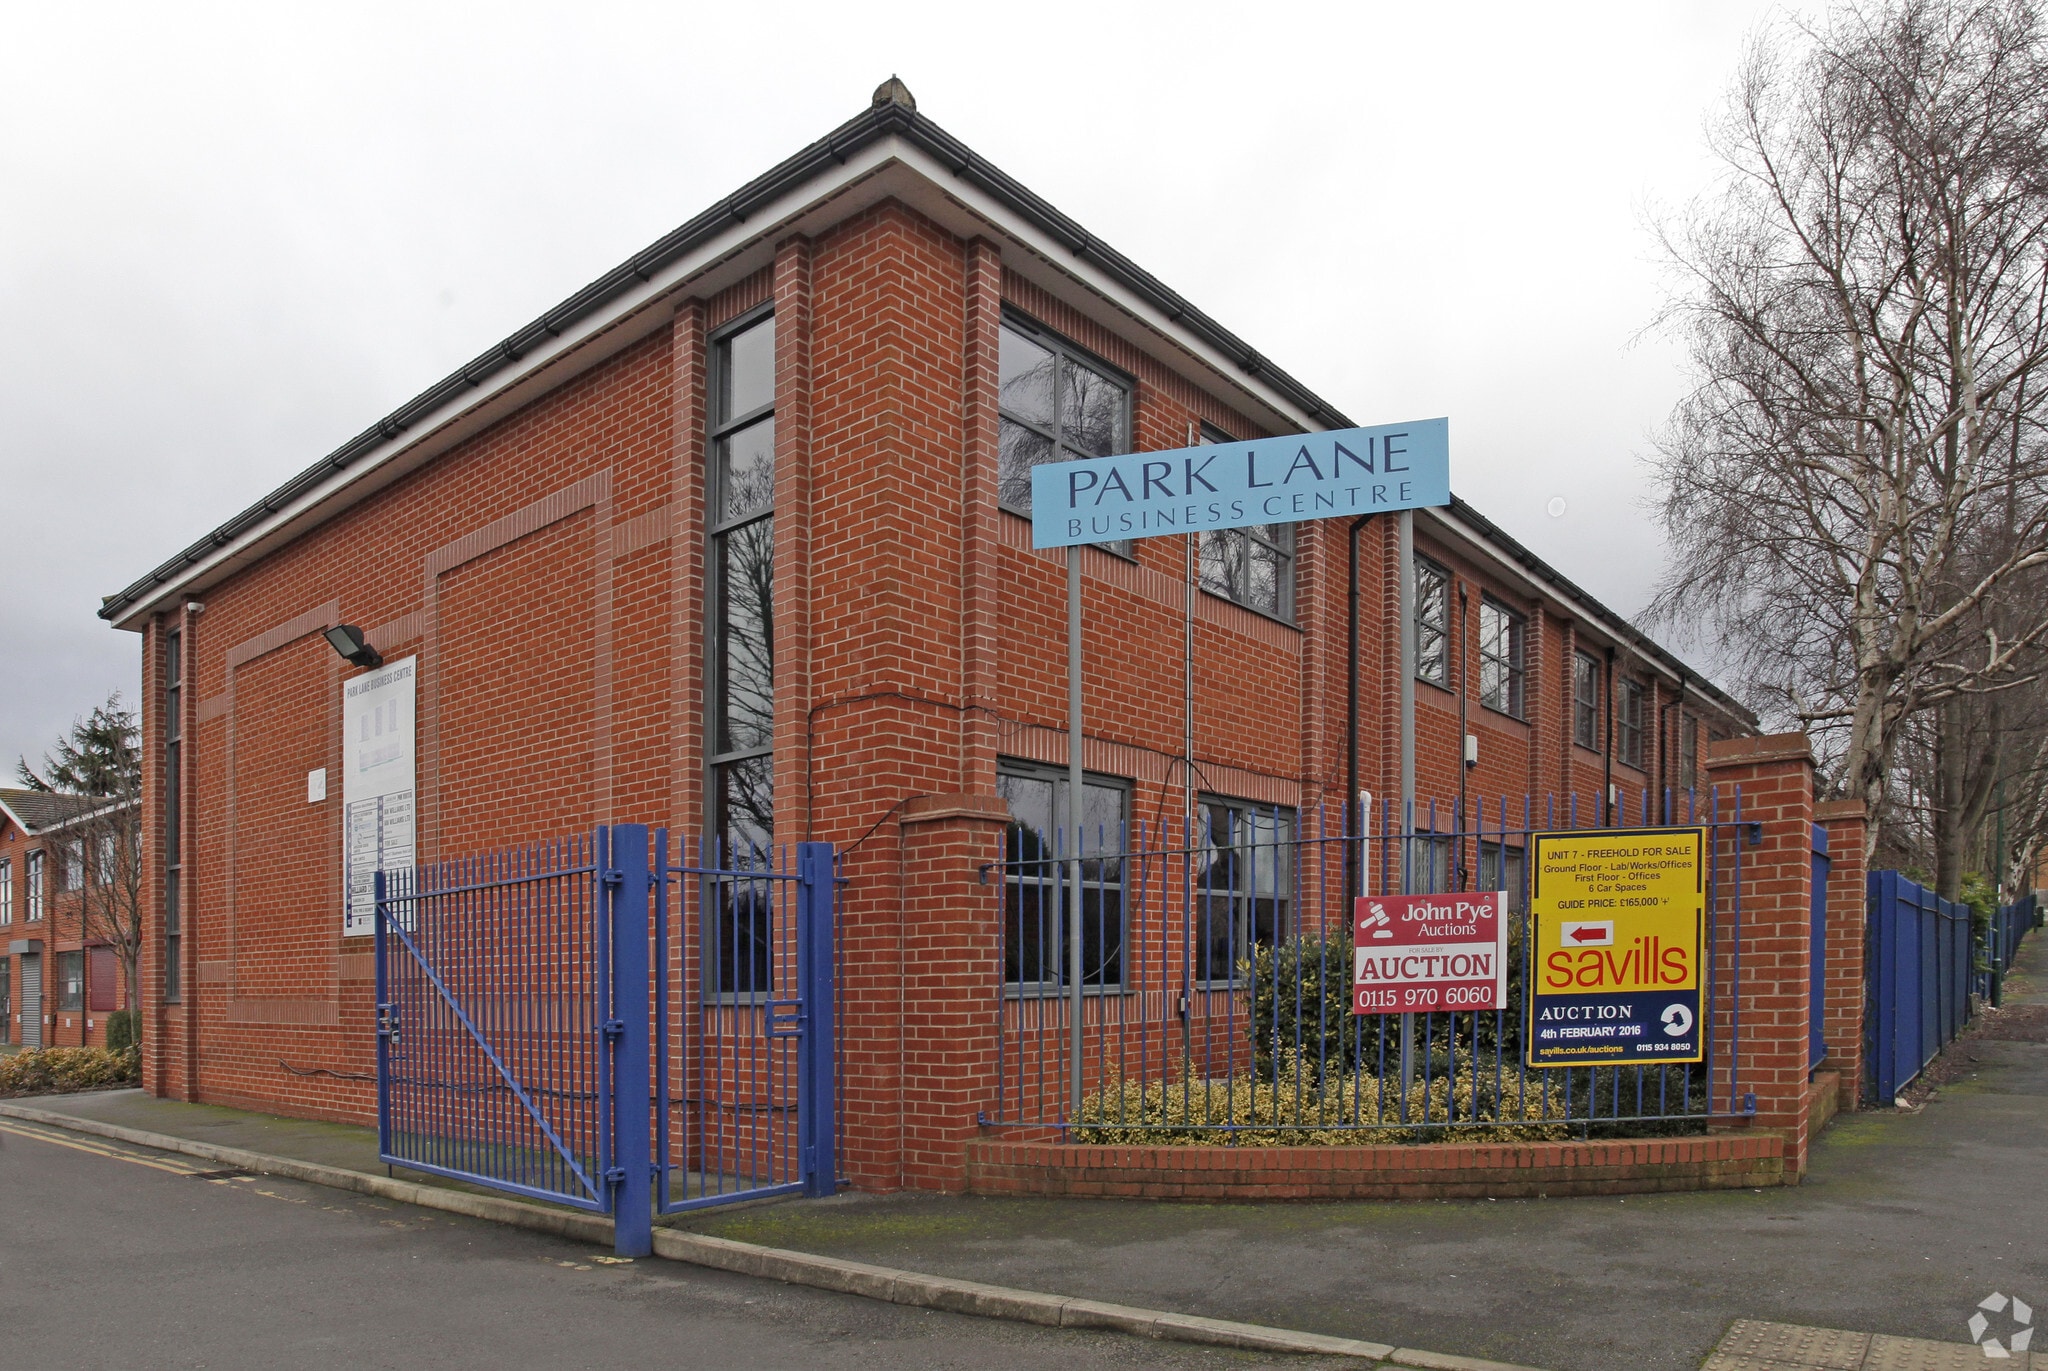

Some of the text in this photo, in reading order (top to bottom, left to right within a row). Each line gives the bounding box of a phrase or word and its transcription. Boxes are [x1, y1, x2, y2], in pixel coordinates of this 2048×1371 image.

[1068, 433, 1410, 508] PARK LANE
[1068, 481, 1412, 538] BUSINESS CENTRE
[347, 665, 411, 699] PARK LANE BUSINESS CENTRE
[1548, 851, 1569, 860] UNIT
[1572, 850, 1578, 859] 7
[1587, 848, 1639, 858] FREEHOLD
[1642, 847, 1663, 856] FOR
[1666, 846, 1691, 855] SALE
[1544, 864, 1576, 873] Ground
[1579, 863, 1602, 872] Floor
[1610, 860, 1692, 871] Lab/Works/Offices
[1575, 873, 1594, 882] First
[1597, 872, 1619, 881] Floor
[1628, 871, 1661, 880] Offices
[1588, 883, 1647, 893] 6 Car Spaces
[1558, 900, 1585, 910] GUIDE
[1588, 898, 1617, 908] PRICE:
[1620, 897, 1658, 907] £165,000
[1401, 902, 1493, 924] John Pye
[1418, 923, 1477, 937] Auctions
[1360, 953, 1492, 980] AUCTION
[1546, 936, 1688, 988] savills
[1359, 986, 1491, 1007] 0115 970 6060
[1539, 1005, 1633, 1021] AUCTION
[1540, 1025, 1641, 1039] 4th FEBRUARY 2016
[1540, 1044, 1624, 1057] savills.co.uk/auctions
[1636, 1043, 1653, 1052] 0115
[1654, 1043, 1669, 1051] 934
